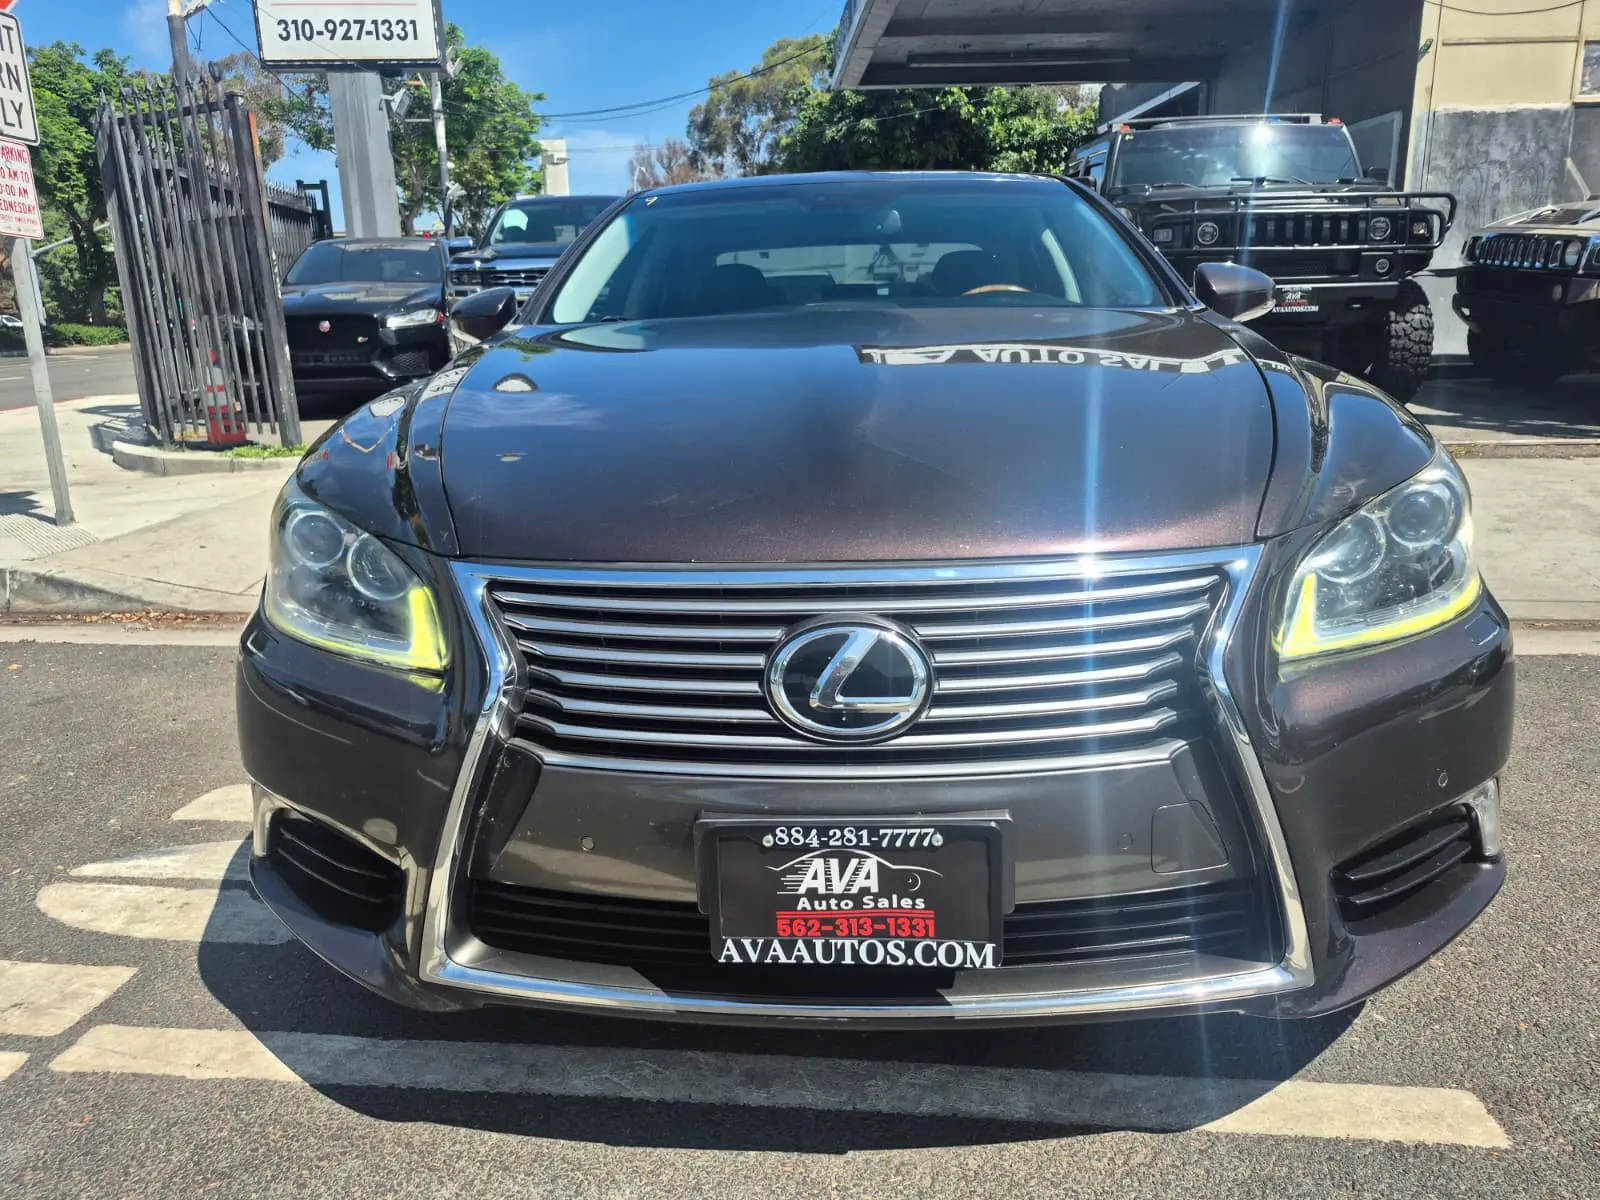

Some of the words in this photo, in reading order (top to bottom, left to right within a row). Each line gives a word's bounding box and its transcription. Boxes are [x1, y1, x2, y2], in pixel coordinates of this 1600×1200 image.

[277, 19, 418, 41] 310-927-1331
[775, 826, 935, 848] 884-281-7777
[797, 857, 880, 894] AVA
[796, 897, 854, 911] Auto
[862, 894, 926, 910] Sales
[776, 917, 936, 938] 562-313-1331
[717, 938, 997, 969] AVAAUTOS.COM
